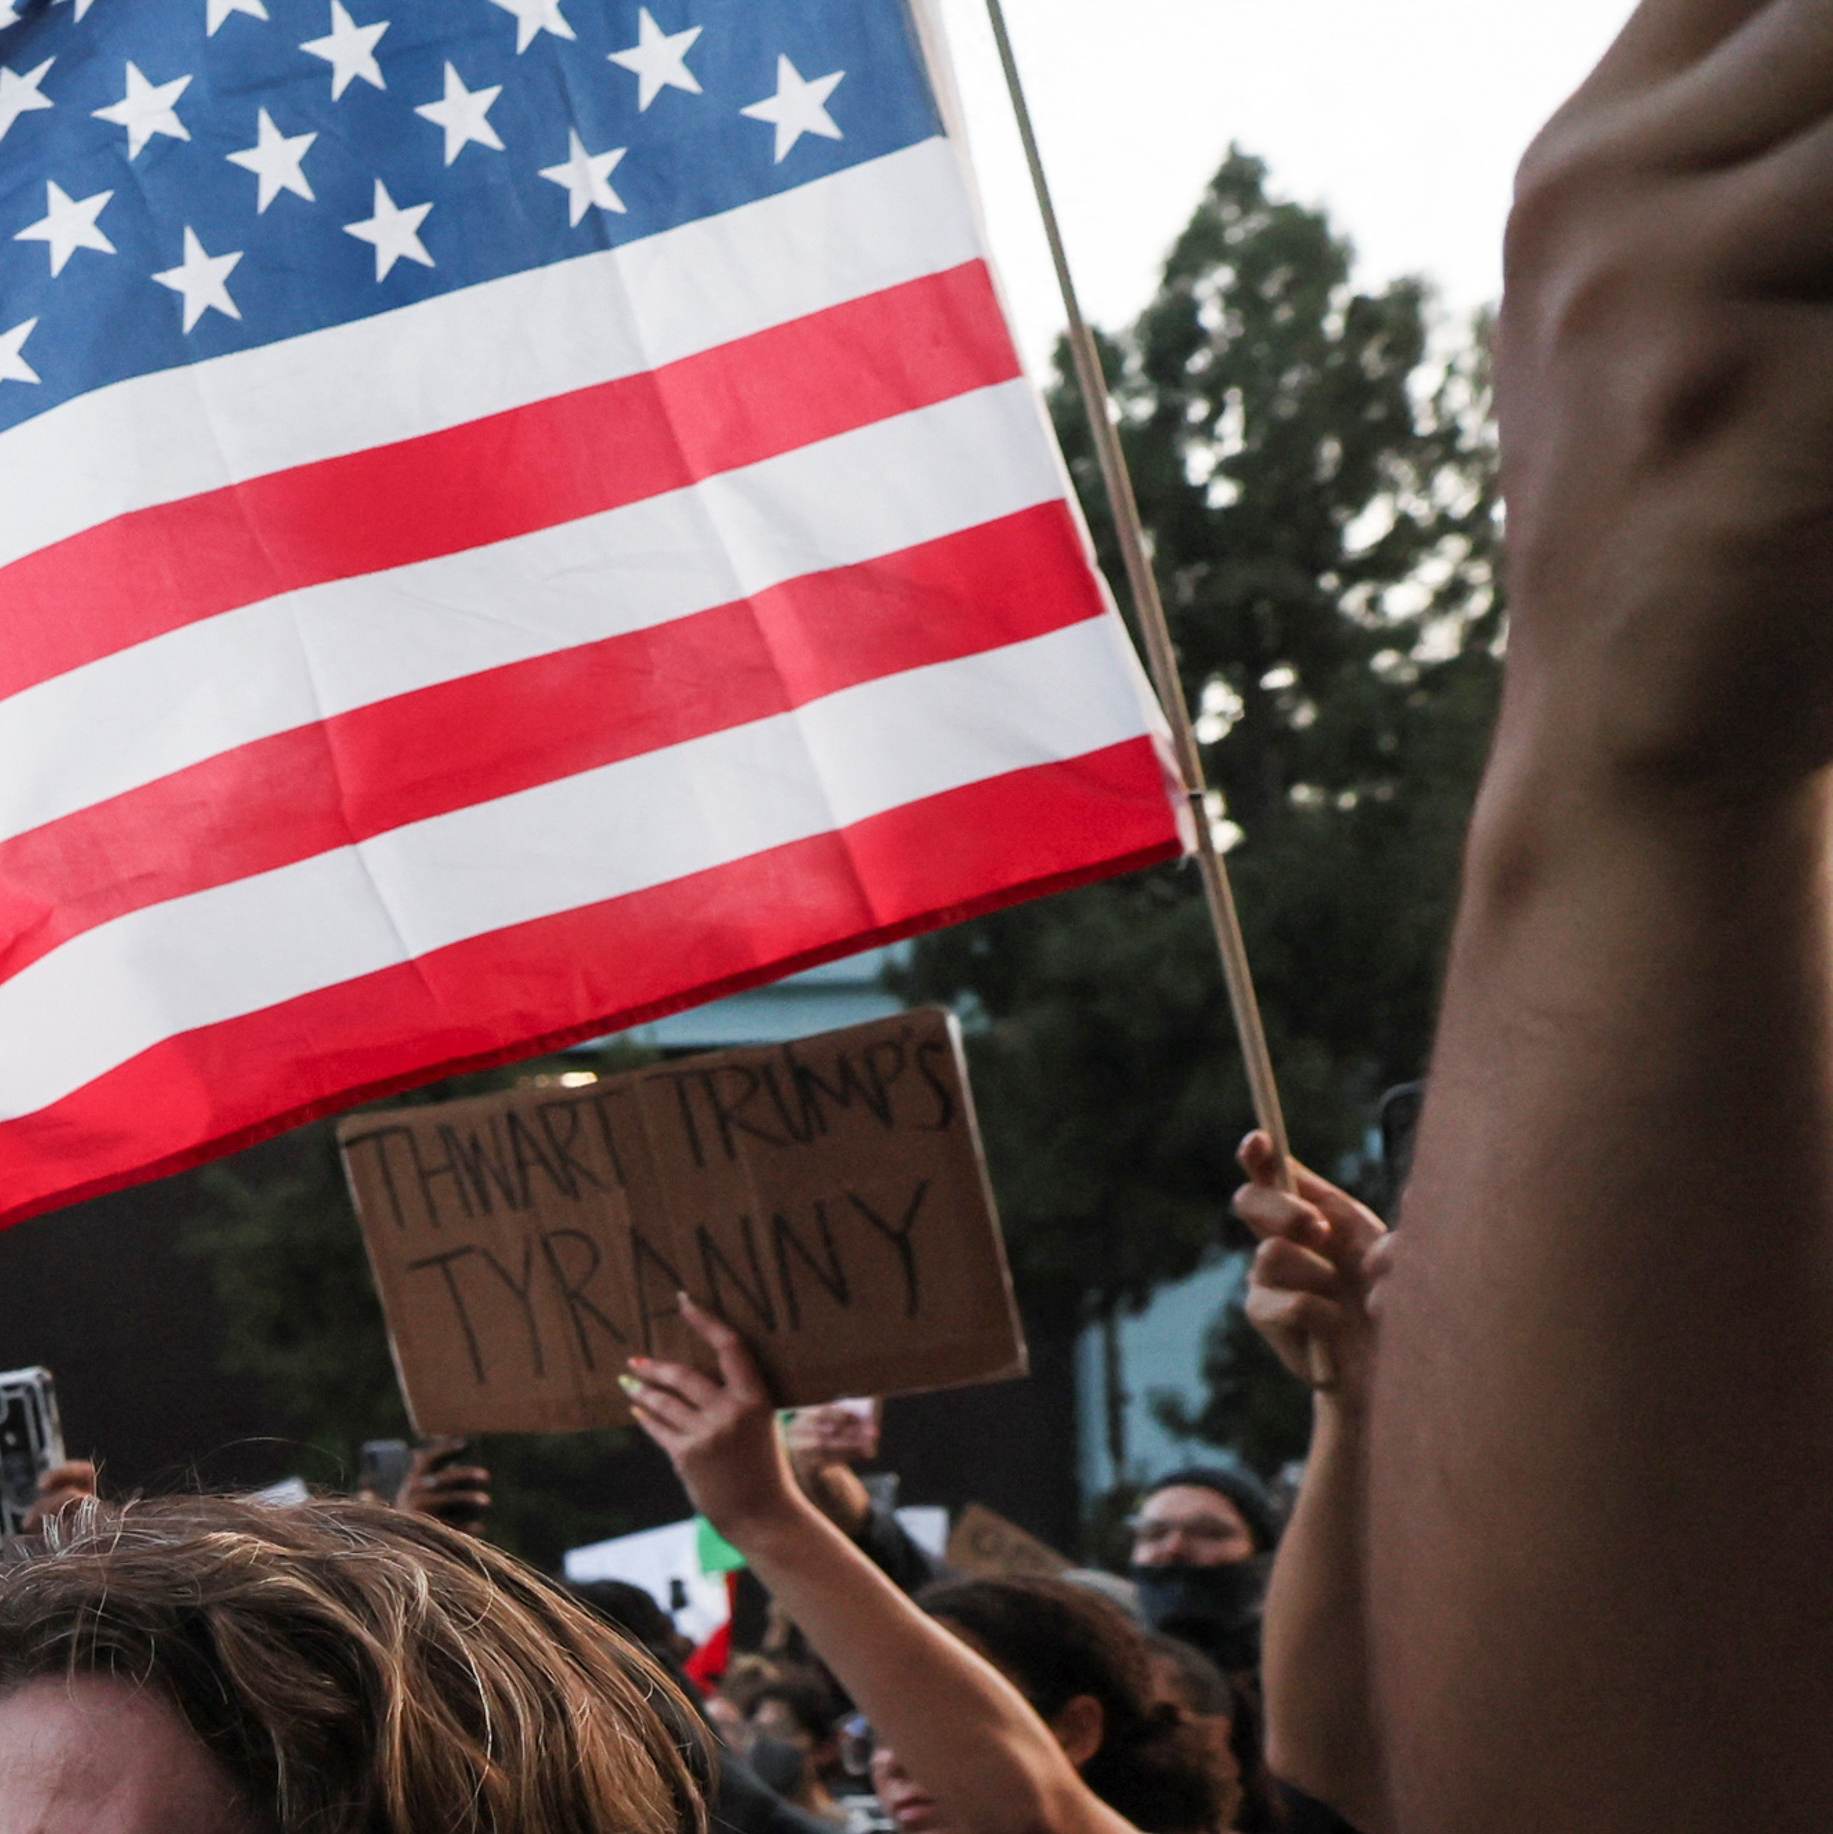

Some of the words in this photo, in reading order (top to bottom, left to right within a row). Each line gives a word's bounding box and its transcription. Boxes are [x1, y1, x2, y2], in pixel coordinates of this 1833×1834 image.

[342, 1091, 629, 1228] THWART
[644, 1025, 958, 1169] TRUMP'S
[408, 1180, 929, 1386] TYRANNY
